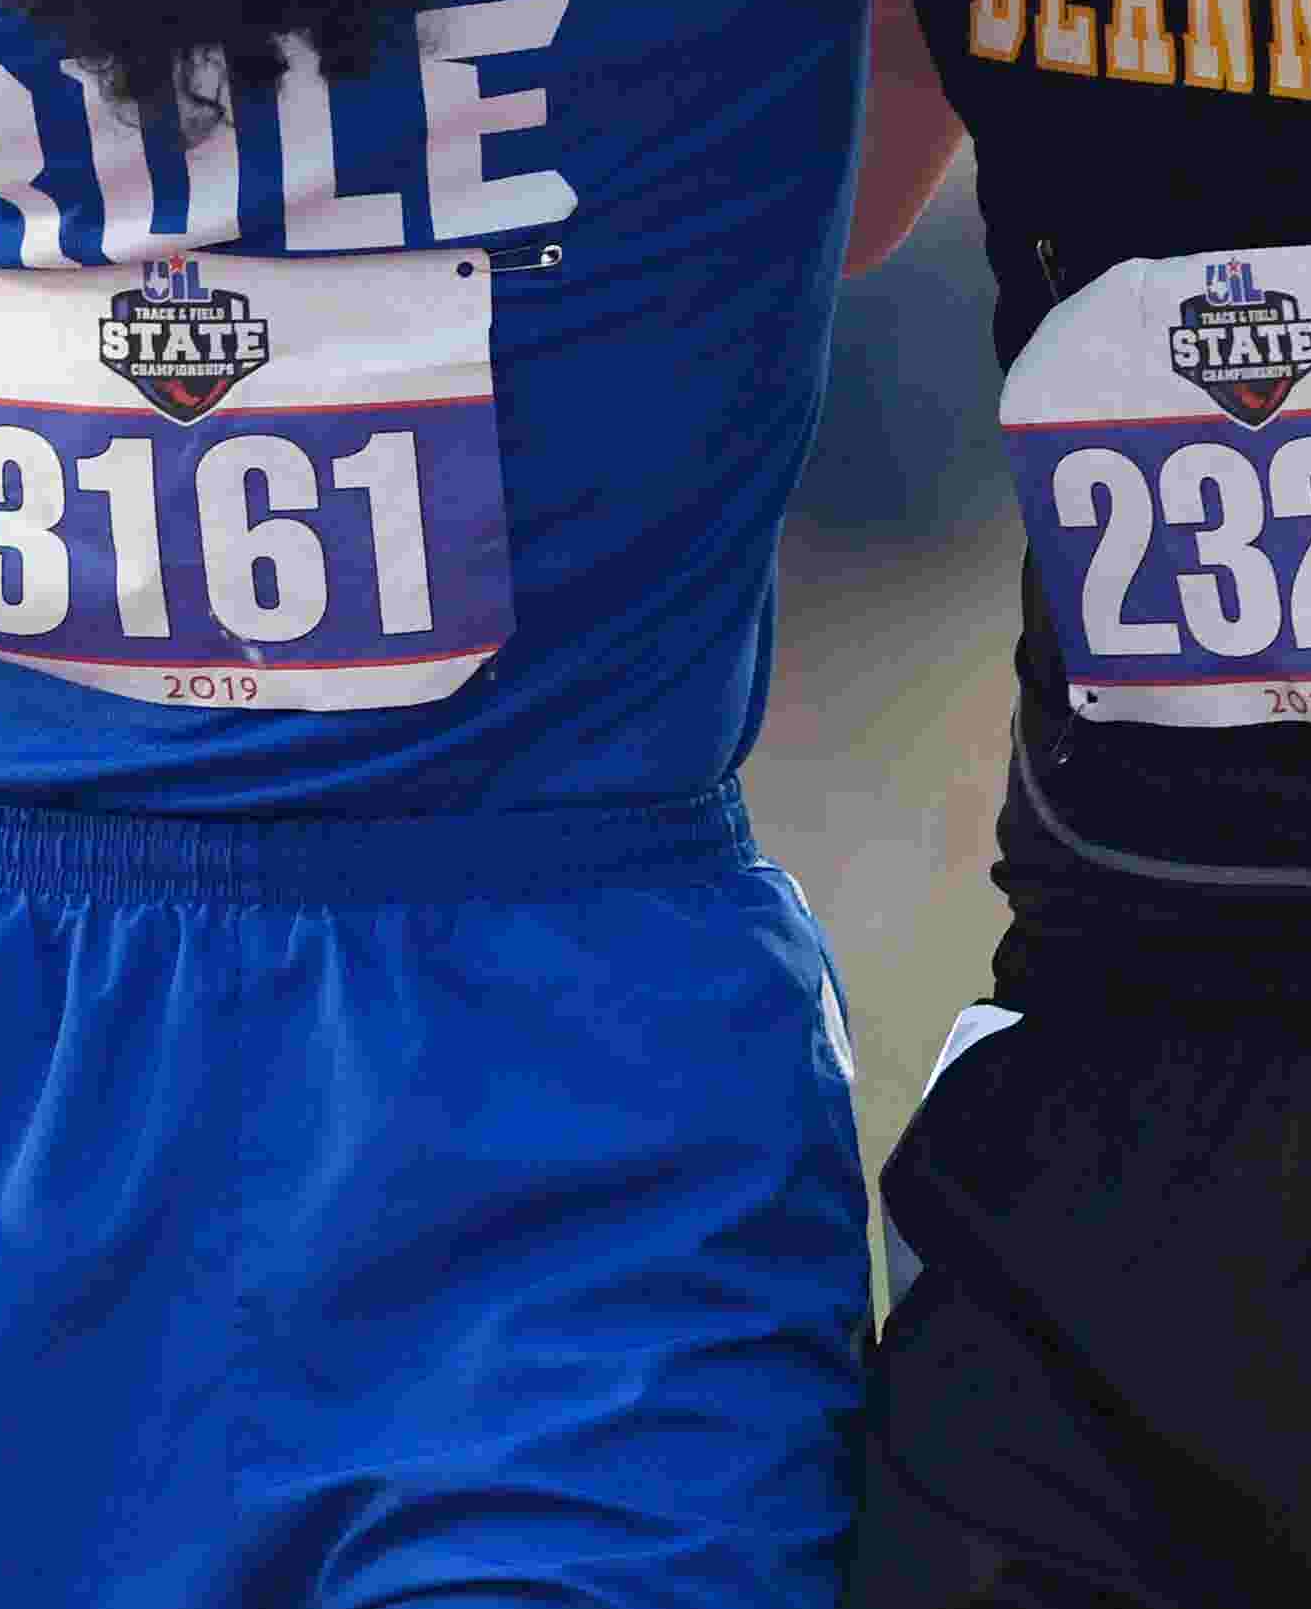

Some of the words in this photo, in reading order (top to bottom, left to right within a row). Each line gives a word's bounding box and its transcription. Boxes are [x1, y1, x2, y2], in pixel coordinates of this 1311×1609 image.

[134, 307, 176, 320] TRACK
[189, 307, 225, 320] FIELD
[102, 322, 265, 361] STATE
[130, 362, 235, 376] CHAMPIONSHIPS
[162, 673, 259, 704] 2019
